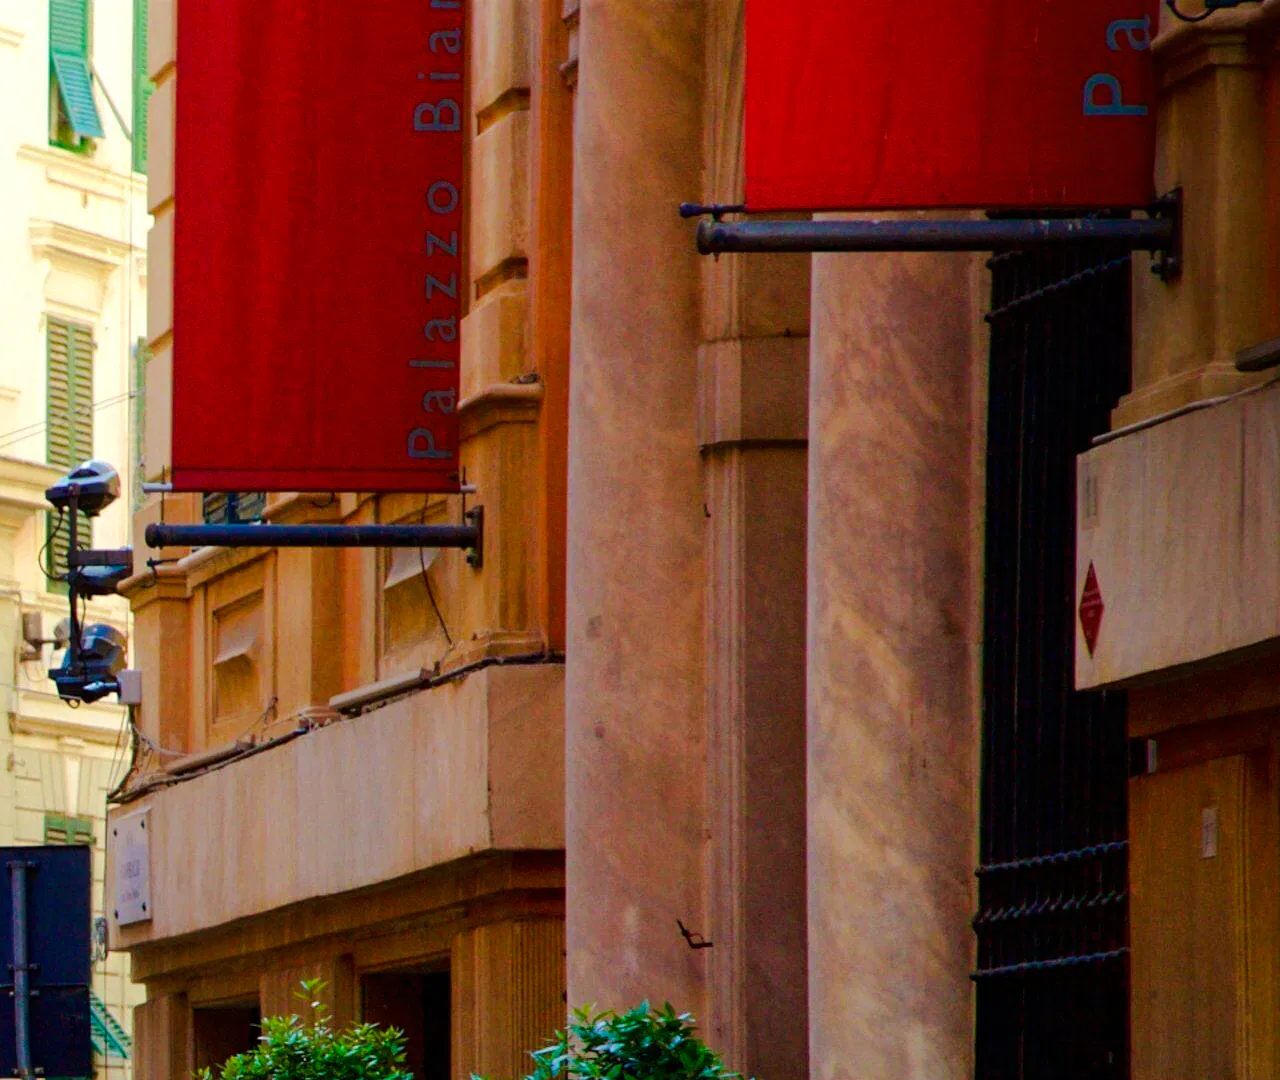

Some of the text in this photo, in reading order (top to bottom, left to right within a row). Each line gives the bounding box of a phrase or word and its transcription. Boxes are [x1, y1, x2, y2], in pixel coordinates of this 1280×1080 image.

[1083, 14, 1150, 116] Pa
[407, 0, 462, 460] Palazzo Bia
